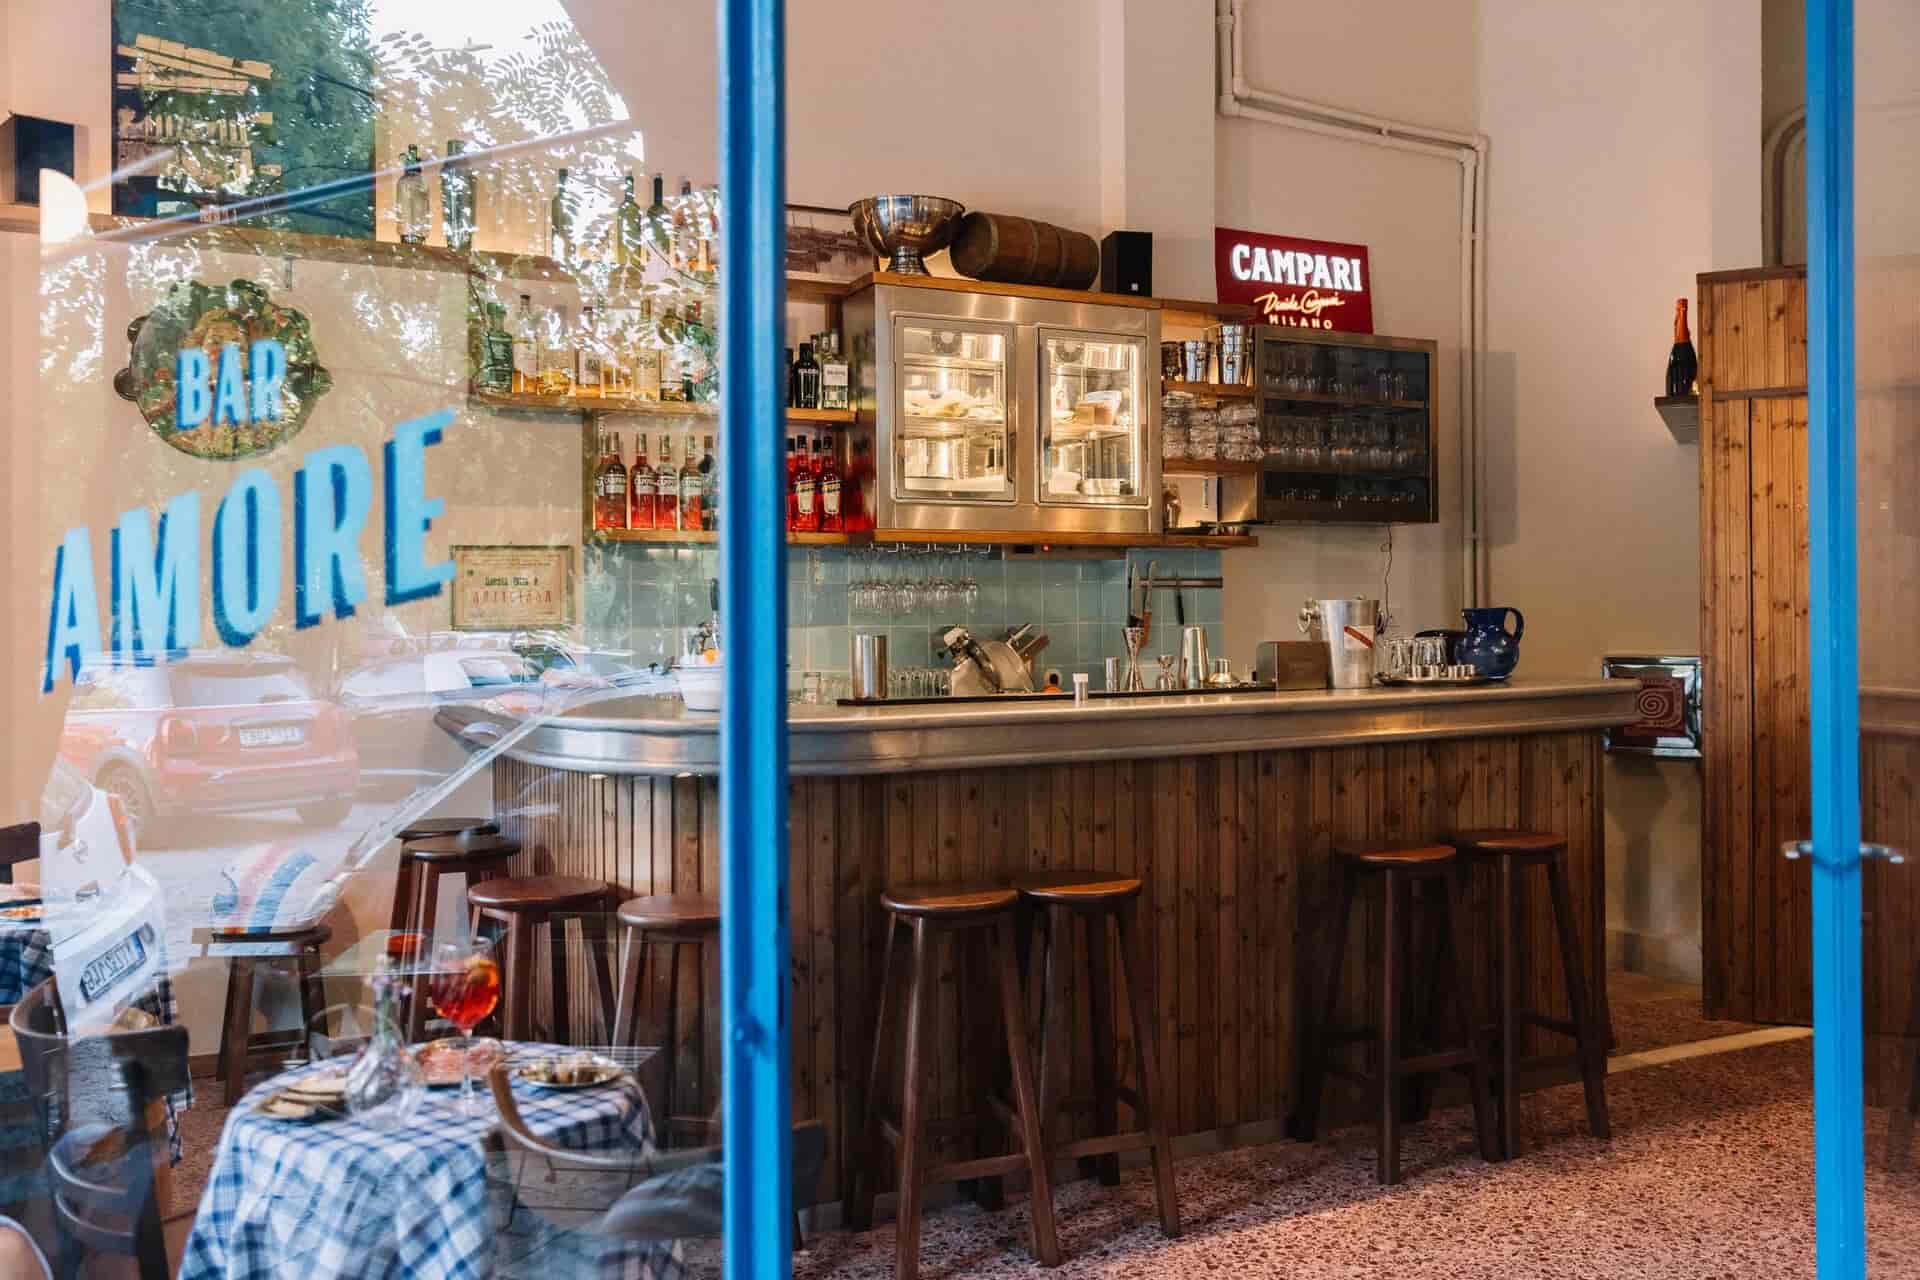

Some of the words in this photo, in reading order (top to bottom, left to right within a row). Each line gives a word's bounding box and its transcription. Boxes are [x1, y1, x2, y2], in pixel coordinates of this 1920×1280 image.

[1232, 243, 1363, 293] CAMPARI
[1268, 313, 1334, 330] MILANO
[176, 337, 287, 430] BAR
[42, 408, 457, 693] AMORE
